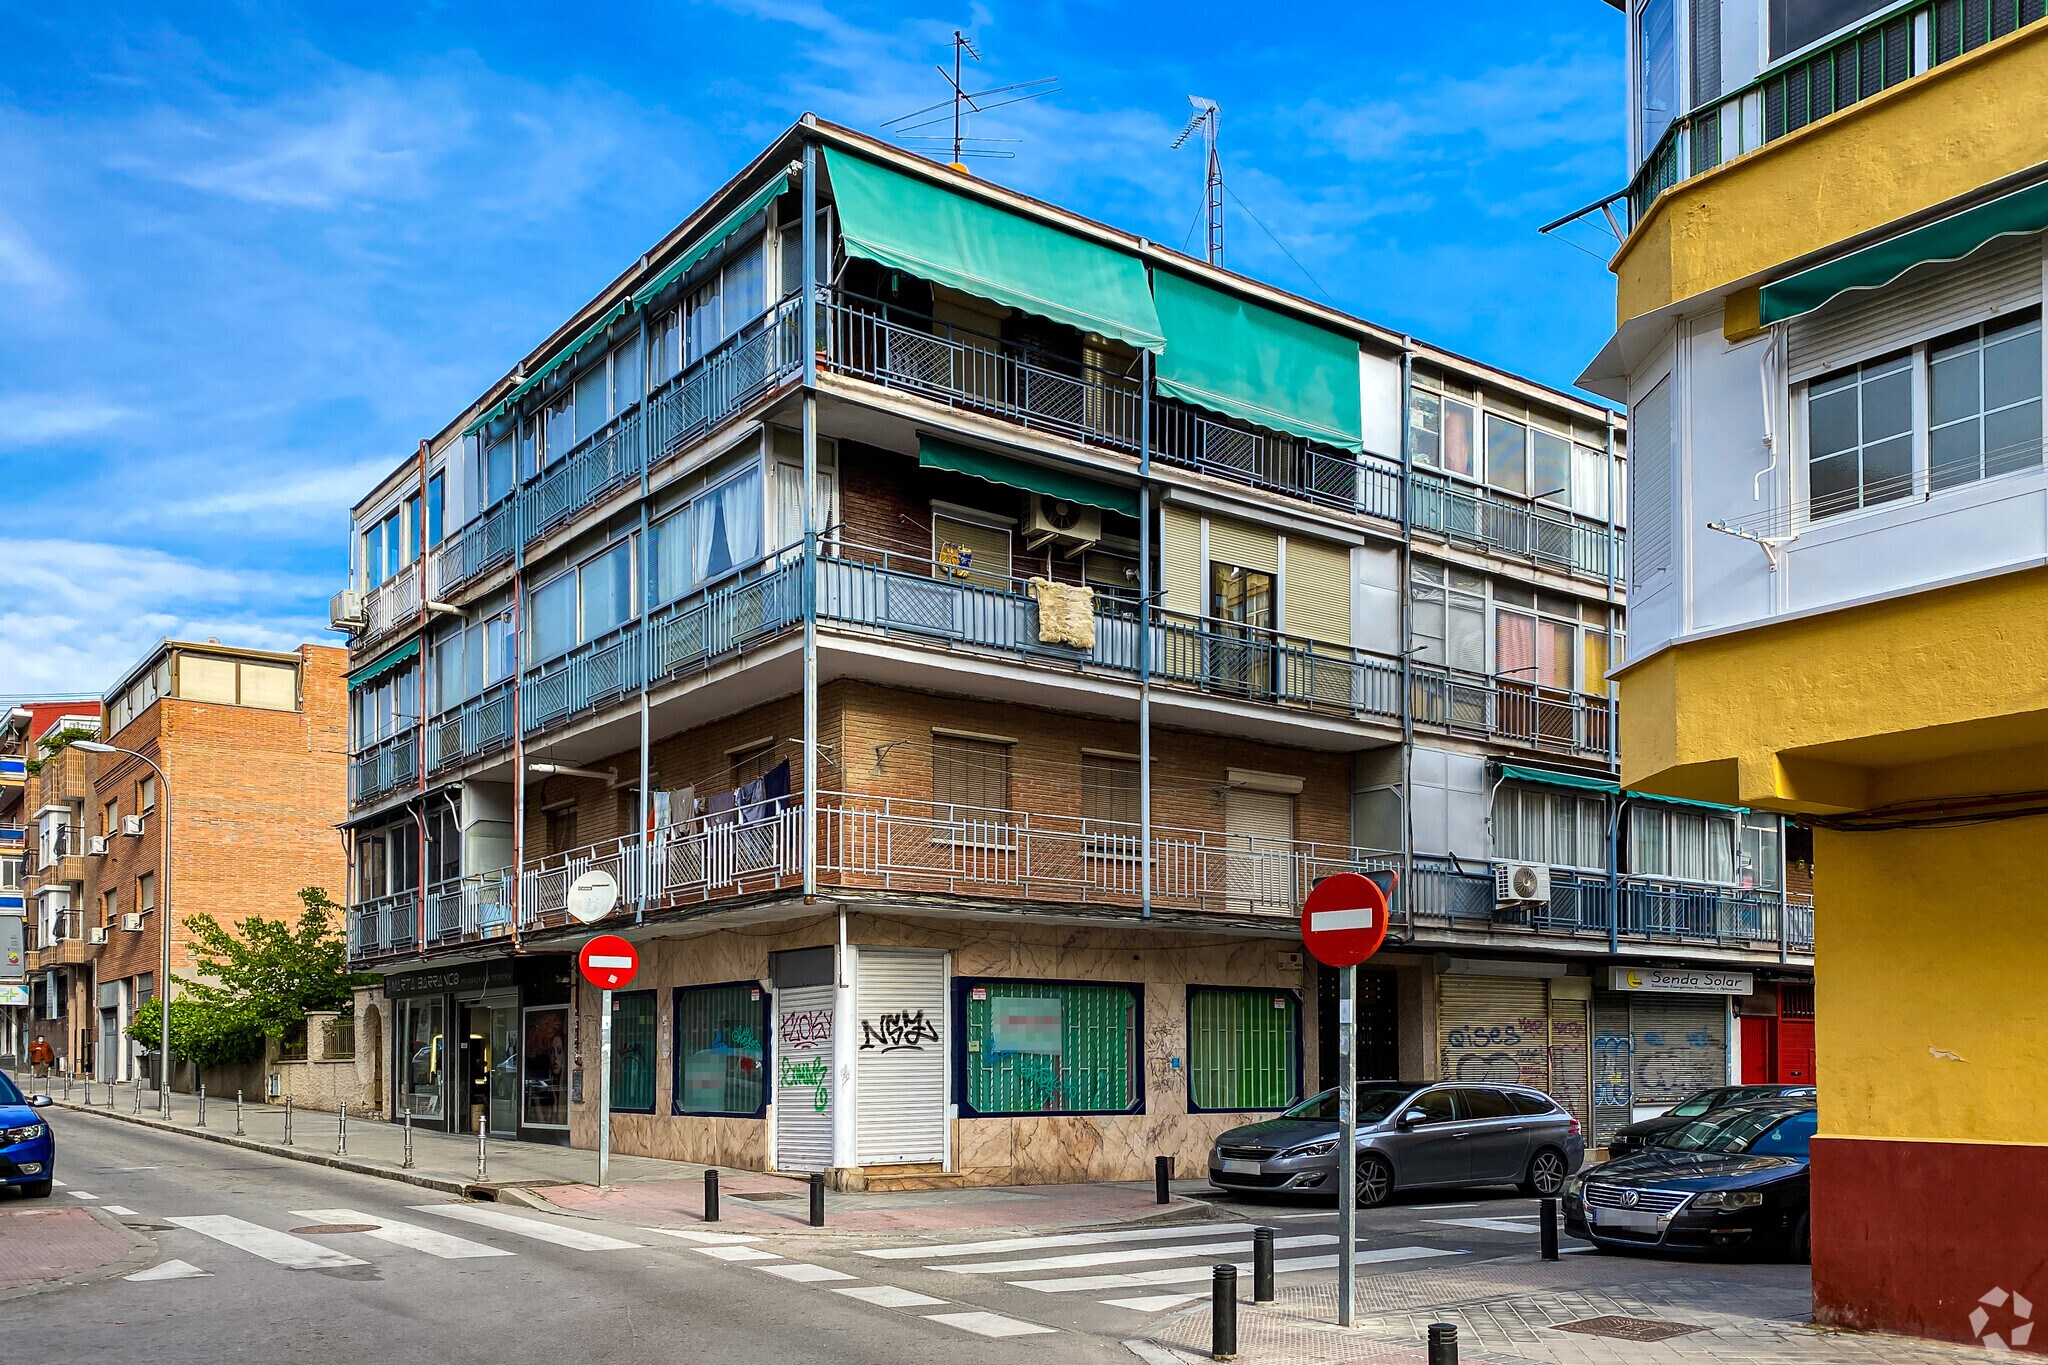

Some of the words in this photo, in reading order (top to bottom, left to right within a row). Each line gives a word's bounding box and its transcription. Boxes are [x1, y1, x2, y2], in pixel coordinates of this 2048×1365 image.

[391, 978, 415, 992] MARTA
[1651, 970, 1698, 985] Senda
[1703, 973, 1742, 987] Solar
